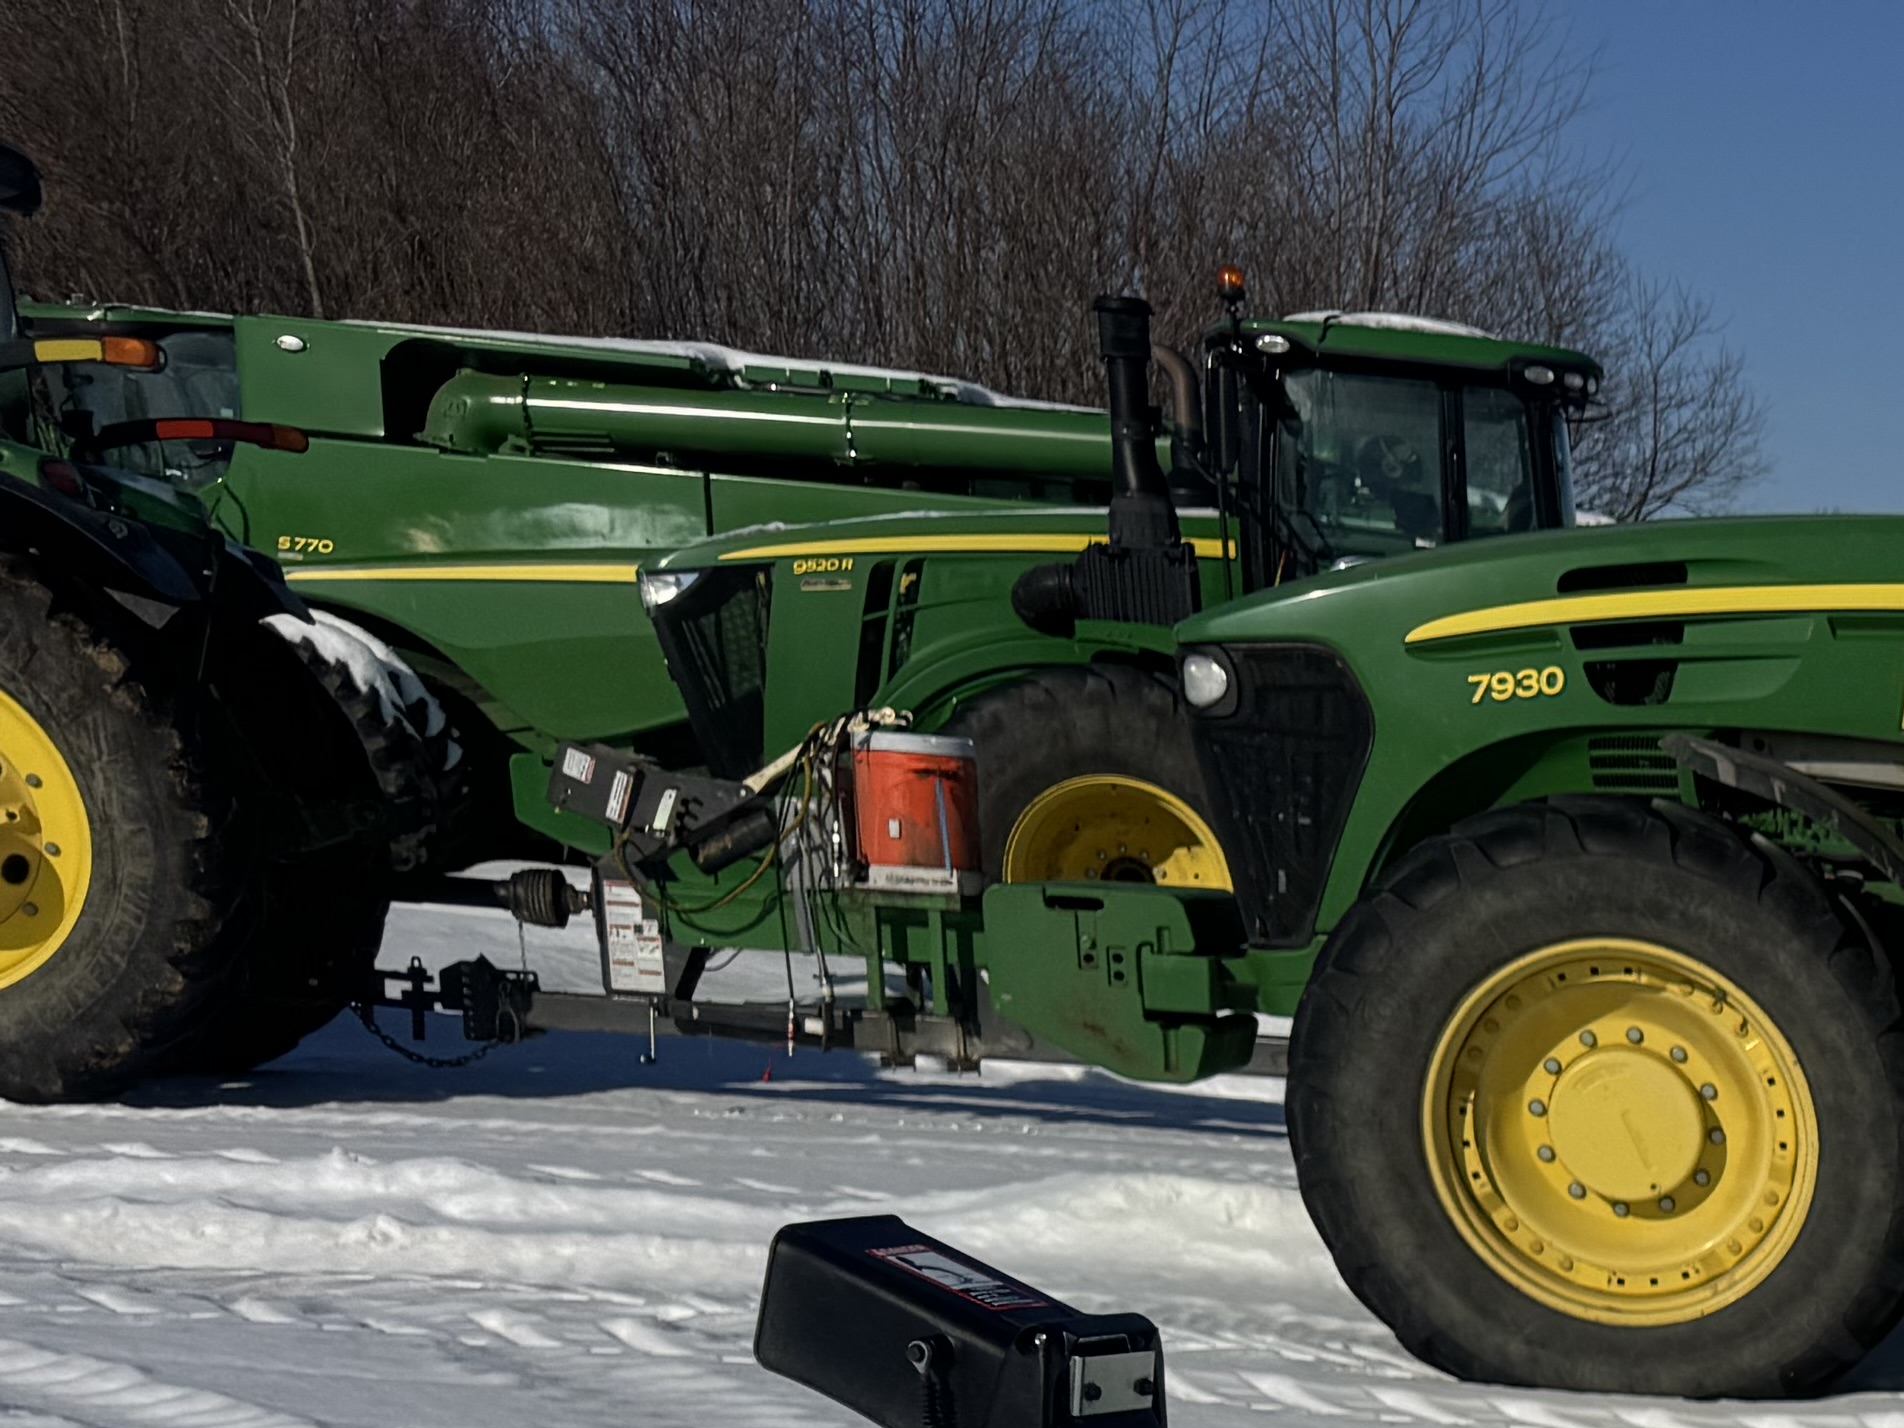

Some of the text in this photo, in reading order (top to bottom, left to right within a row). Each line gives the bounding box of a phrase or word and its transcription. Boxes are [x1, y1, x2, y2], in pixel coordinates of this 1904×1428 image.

[278, 535, 334, 554] S 770
[1467, 665, 1565, 704] 7930
